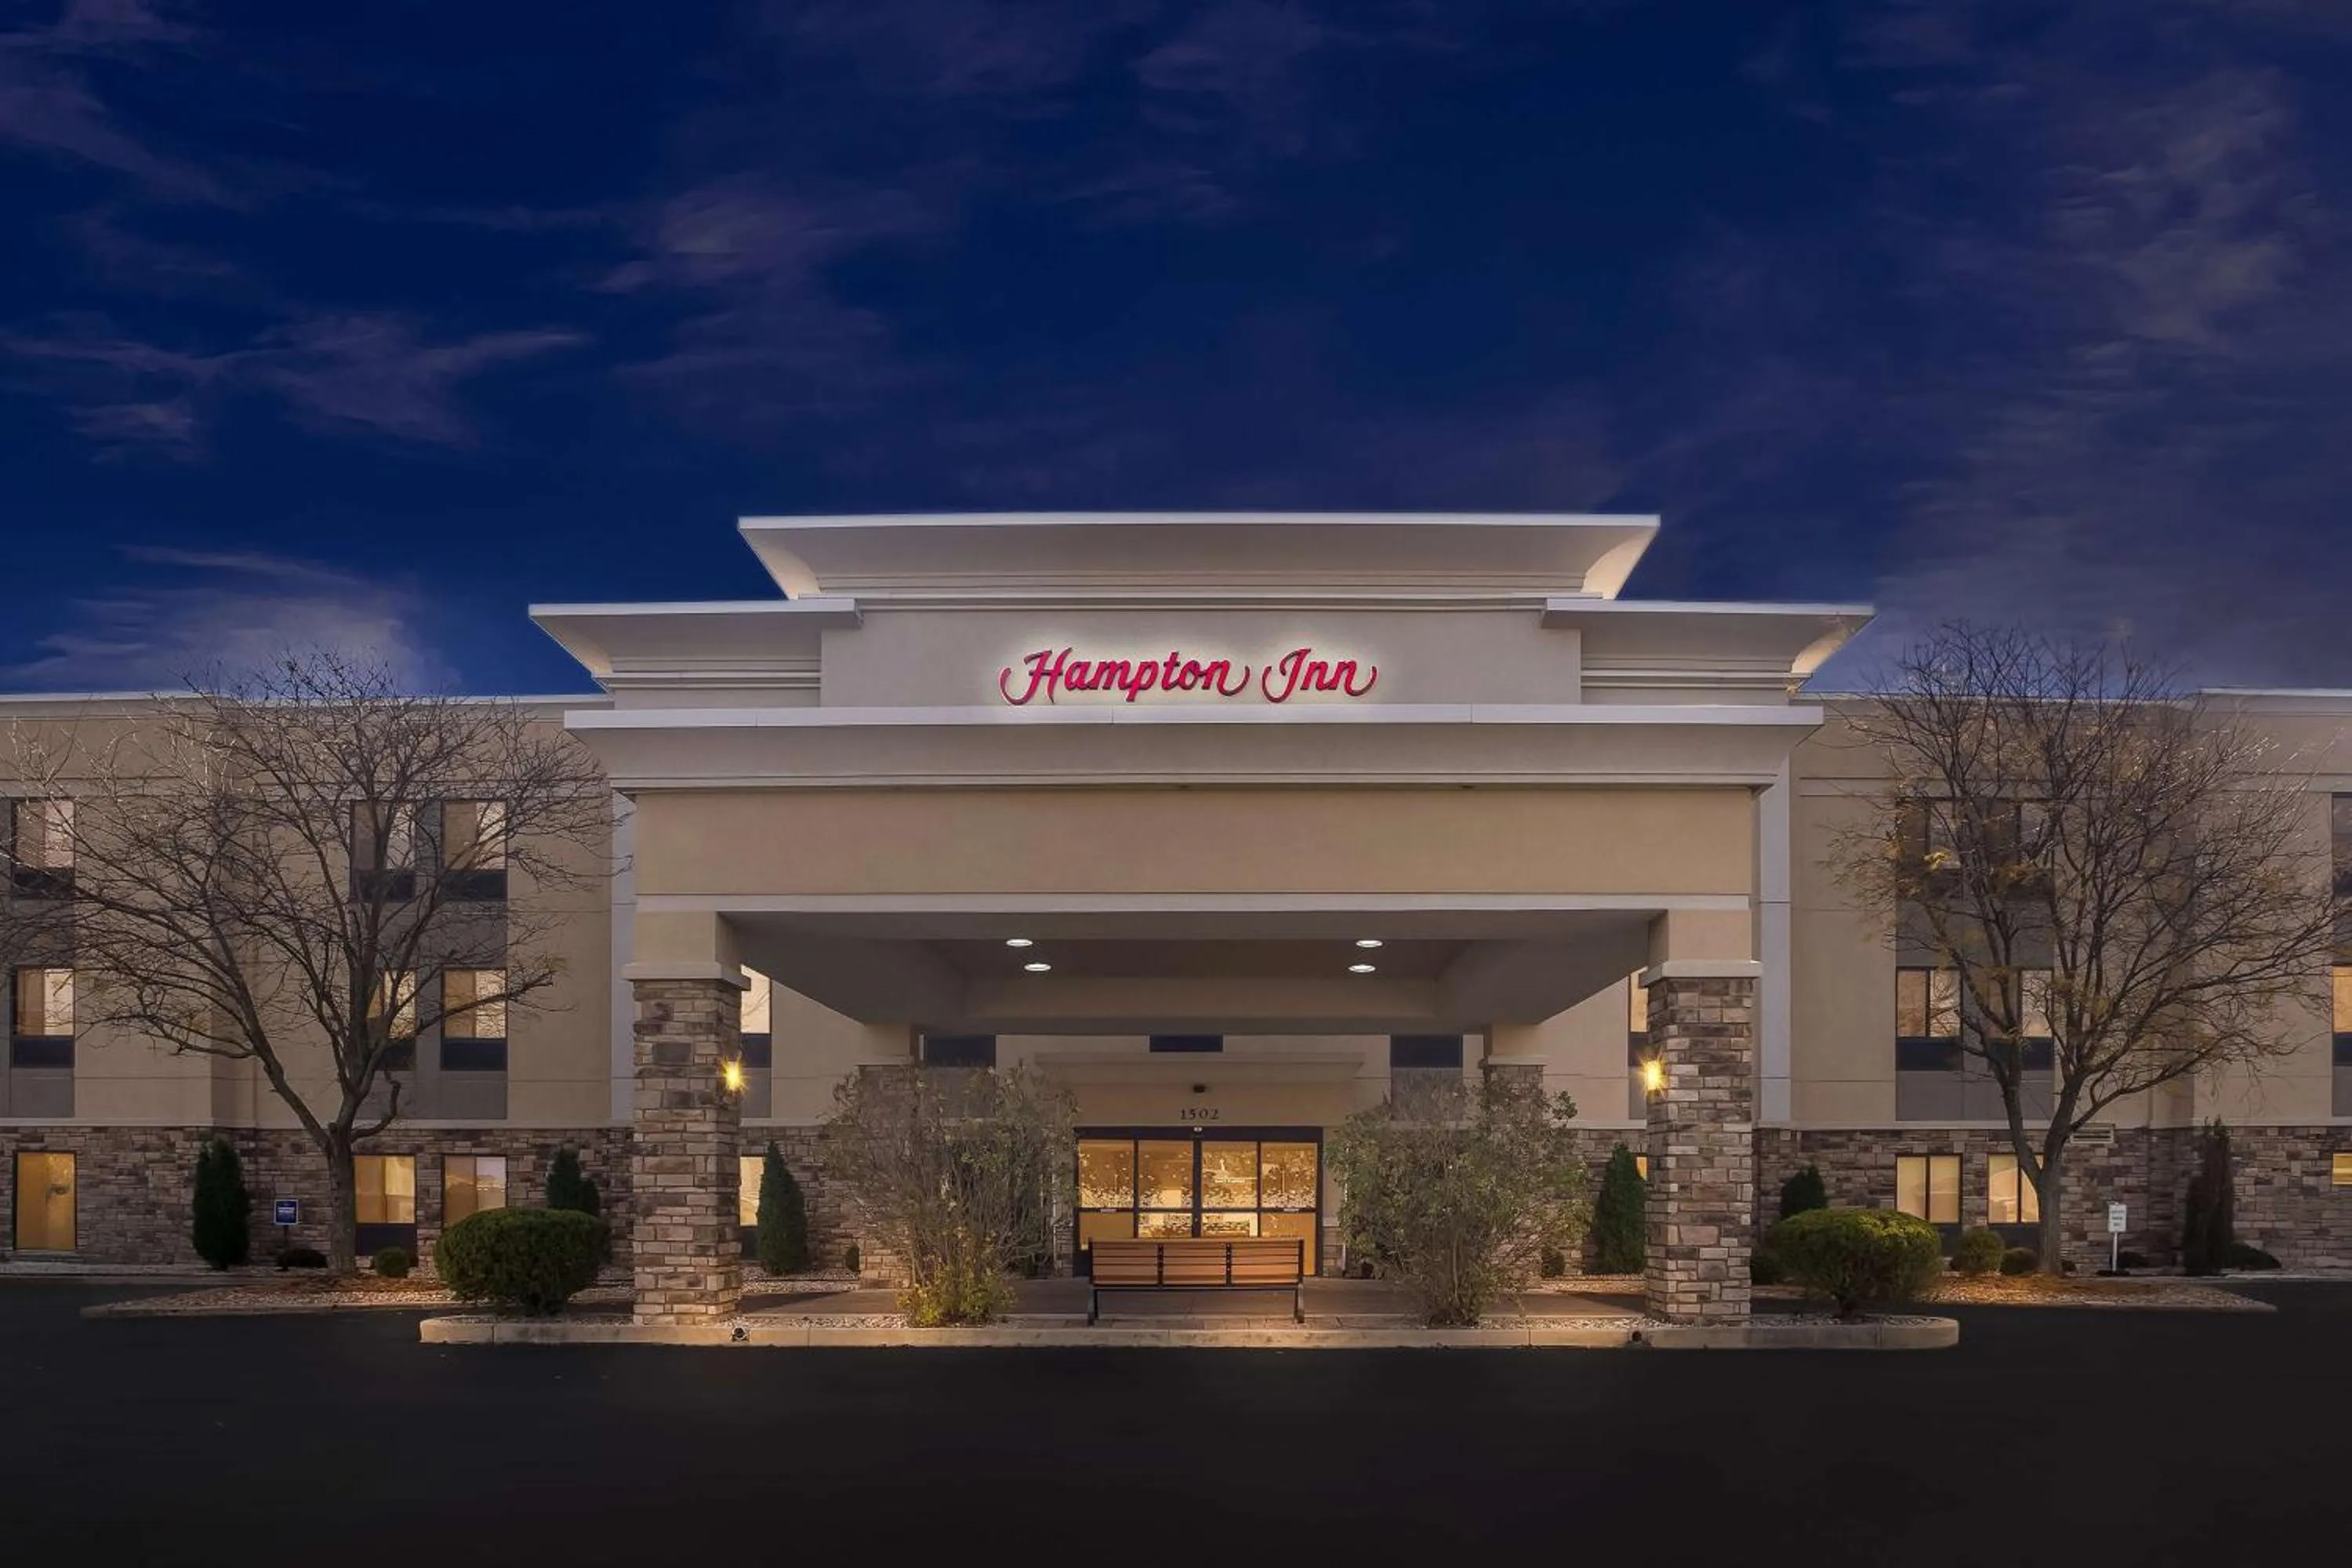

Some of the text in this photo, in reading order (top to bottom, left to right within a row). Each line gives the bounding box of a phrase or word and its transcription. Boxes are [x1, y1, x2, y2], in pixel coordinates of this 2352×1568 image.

[1000, 647, 1377, 706] Hampton Inn
[1180, 1108, 1220, 1120] 1502
